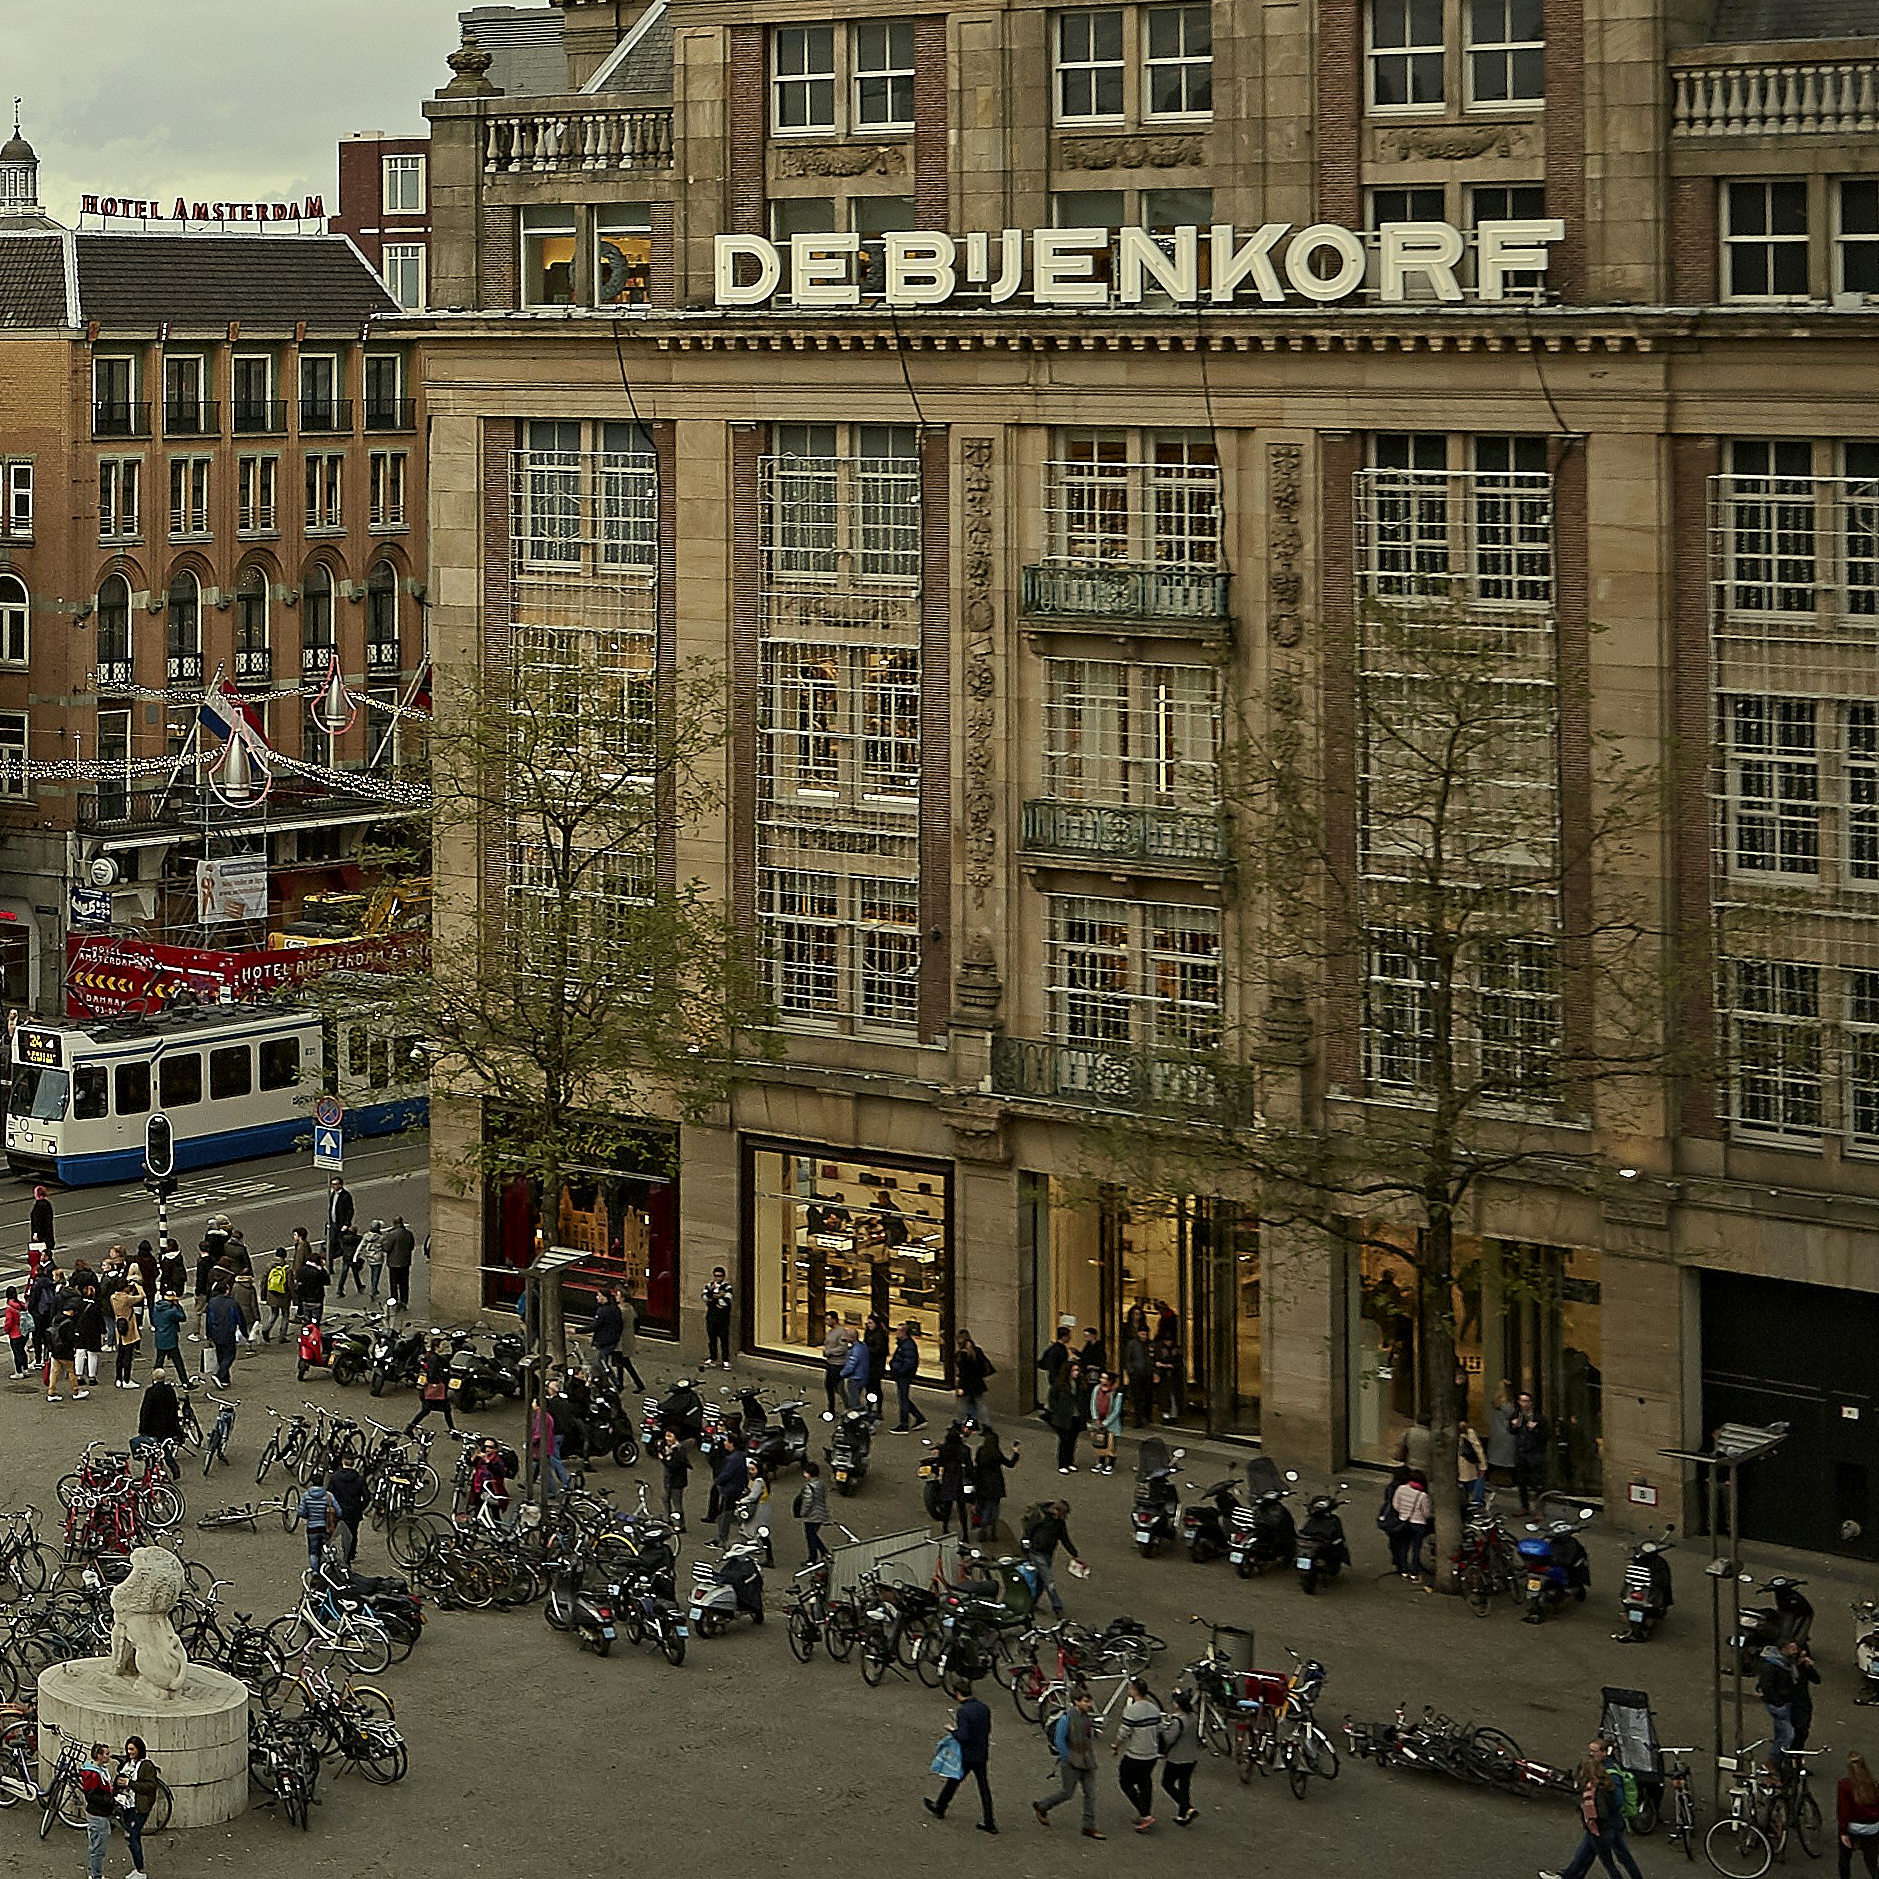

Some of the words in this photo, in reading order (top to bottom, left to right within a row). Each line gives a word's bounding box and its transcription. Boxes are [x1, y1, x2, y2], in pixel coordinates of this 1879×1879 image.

[81, 195, 163, 219] HOTEL
[173, 196, 325, 220] AMSTERDAM
[714, 232, 861, 307] DE
[882, 219, 1565, 305] BIJENKORF
[242, 963, 289, 980] HOTEL
